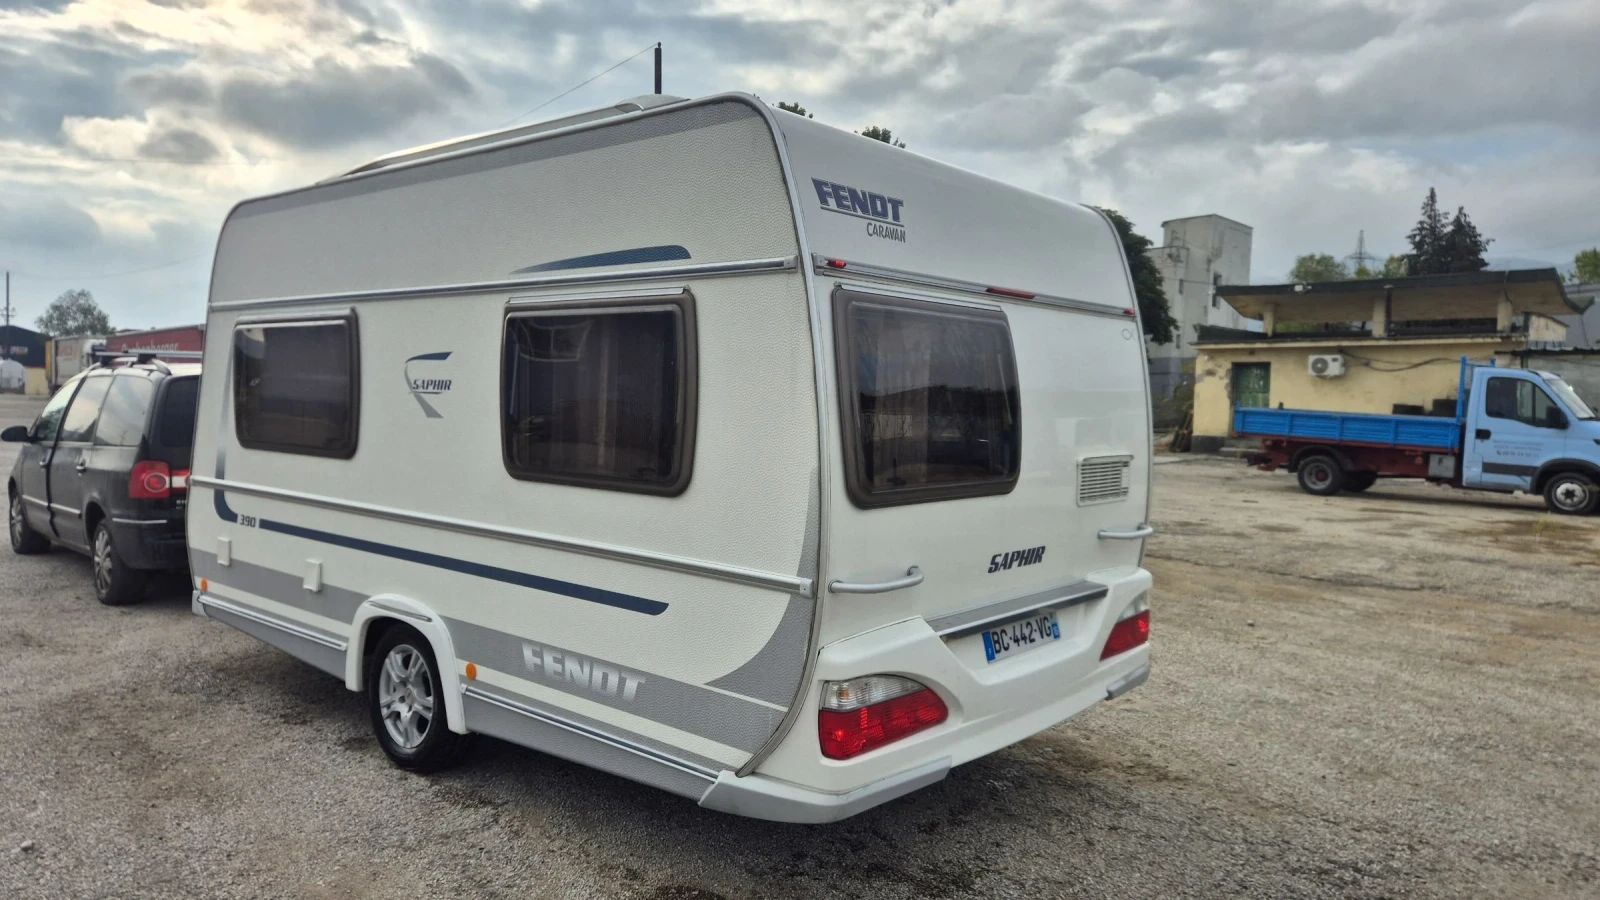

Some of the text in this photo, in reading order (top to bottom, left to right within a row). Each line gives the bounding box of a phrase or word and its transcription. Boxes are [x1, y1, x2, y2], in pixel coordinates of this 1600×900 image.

[811, 177, 904, 222] FENDT
[866, 222, 906, 243] CARAVAN
[412, 379, 452, 391] SAPHIR
[239, 514, 256, 528] 390
[987, 545, 1046, 573] SAPHIR
[991, 616, 1052, 654] BC-442-VG
[521, 641, 647, 700] FENDT
